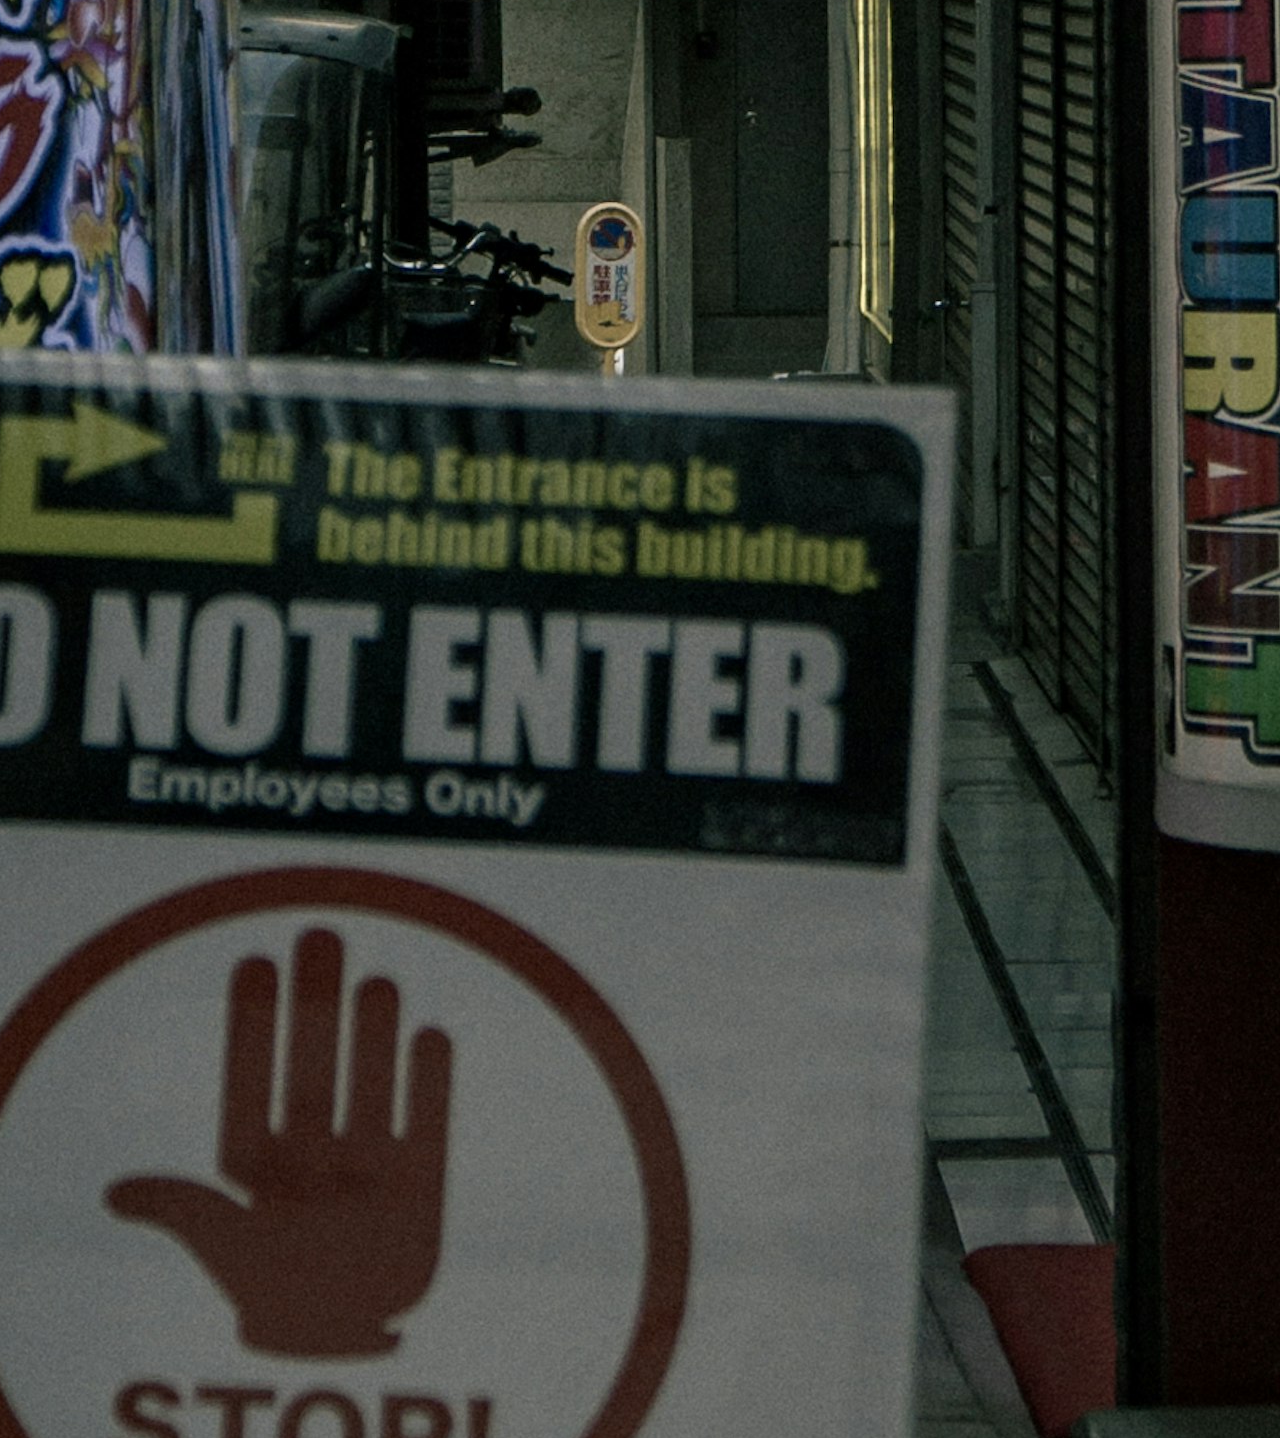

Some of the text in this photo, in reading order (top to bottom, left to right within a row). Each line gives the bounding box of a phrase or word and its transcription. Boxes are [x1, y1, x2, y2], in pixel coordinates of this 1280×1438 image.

[324, 438, 417, 501] The
[431, 446, 672, 512] Entrance
[685, 451, 738, 515] is
[317, 499, 880, 596] behind this building.
[81, 588, 383, 758] NOT
[401, 605, 846, 786] ENTER
[128, 760, 548, 825] Employees Only
